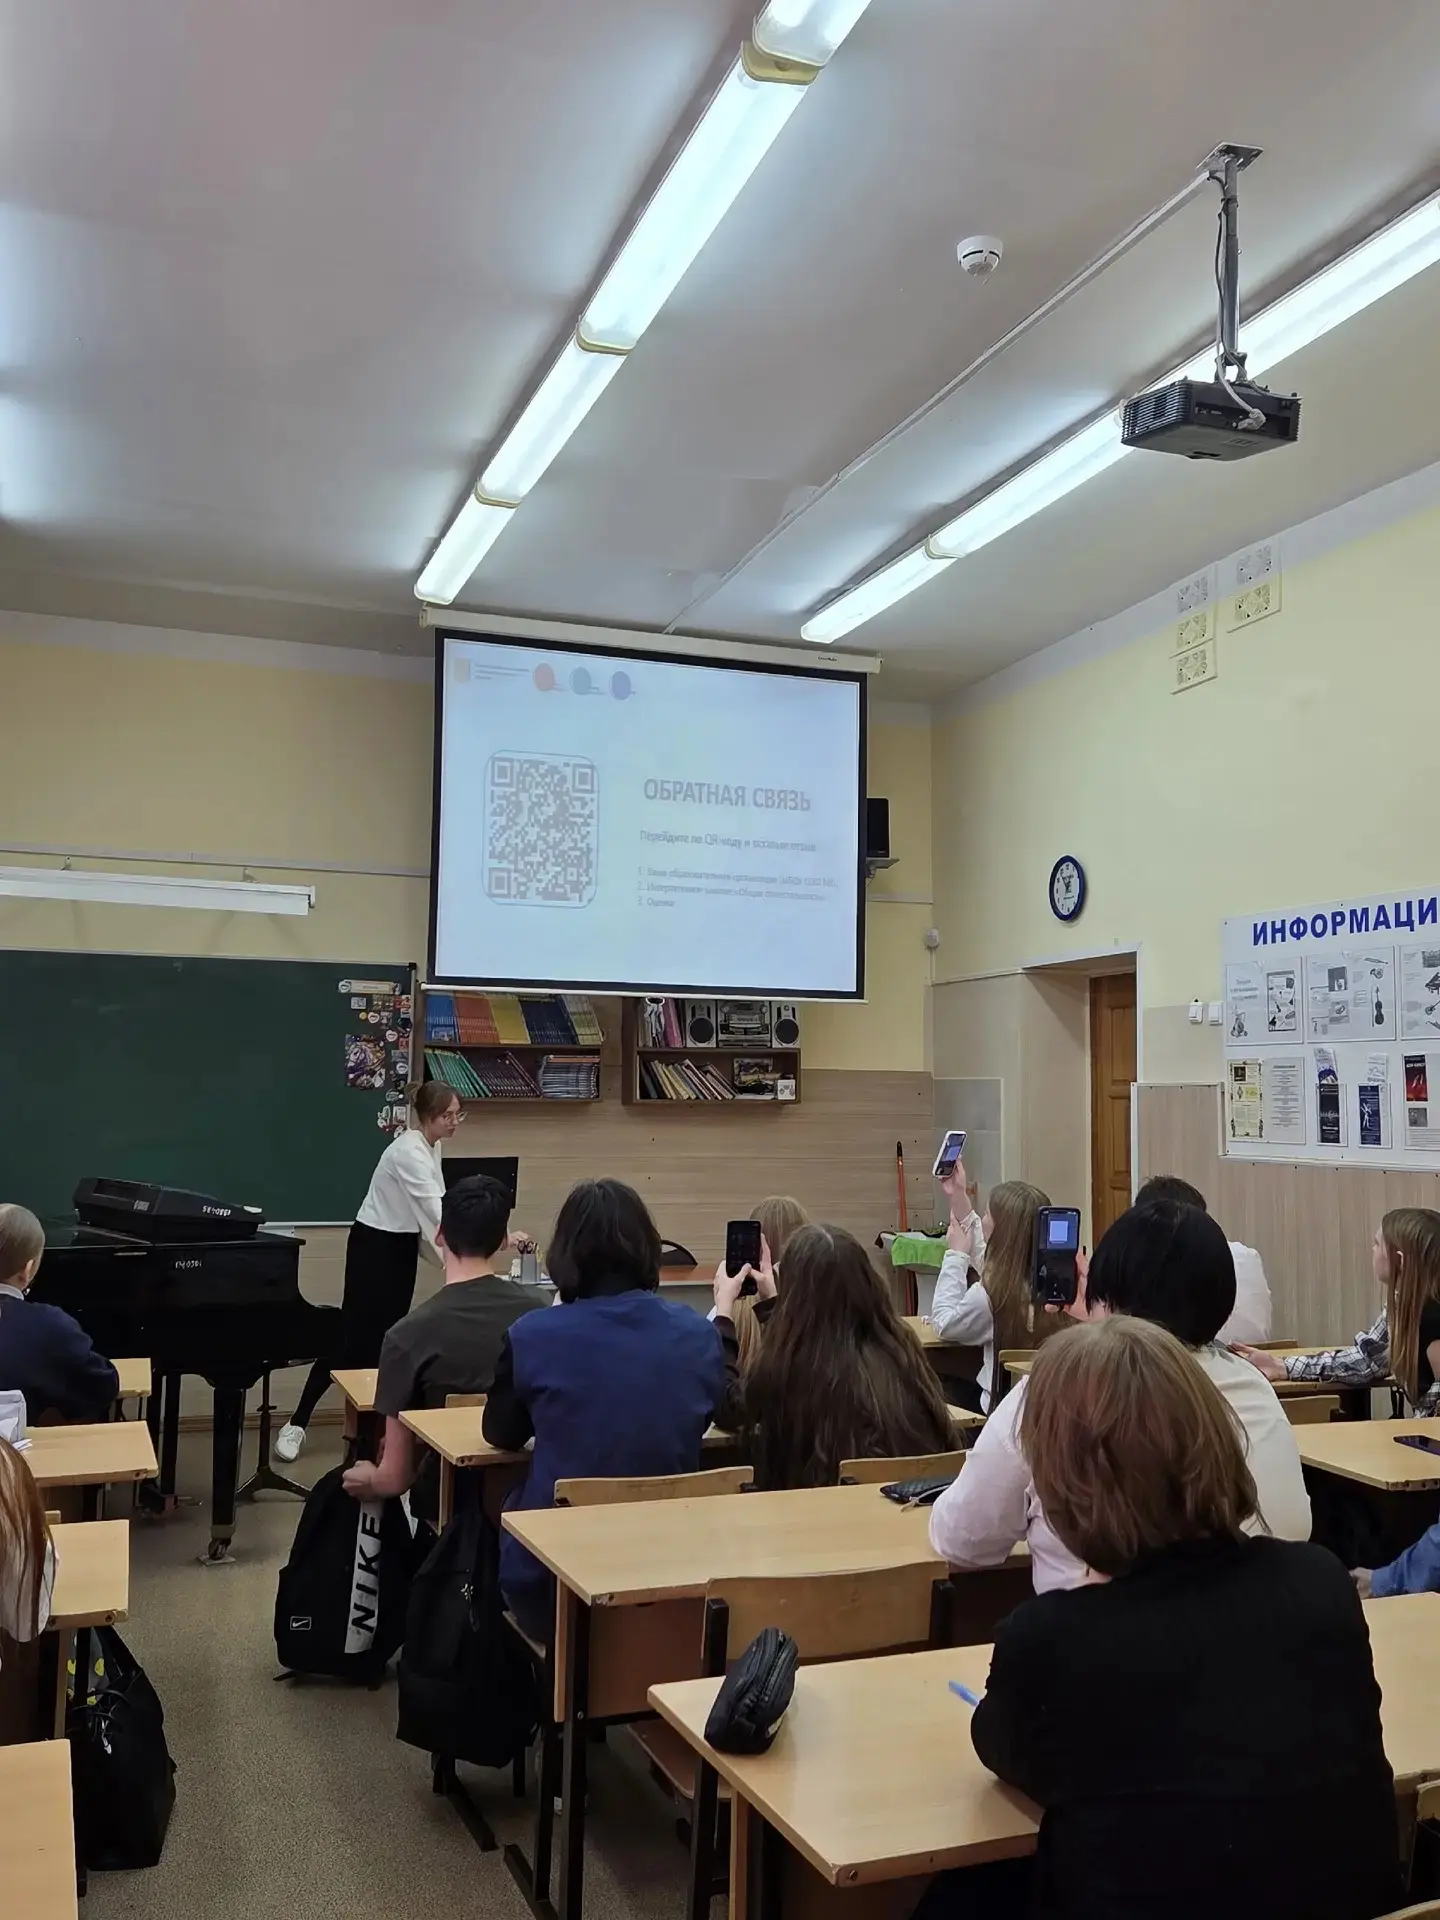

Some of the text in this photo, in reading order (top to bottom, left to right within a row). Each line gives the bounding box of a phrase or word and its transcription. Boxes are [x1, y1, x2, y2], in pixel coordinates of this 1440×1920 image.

[643, 777, 812, 812] ОБРАТНАЯ СВЯЗЬ
[1252, 896, 1438, 947] ИНФОРМАЦИ
[351, 1511, 382, 1634] NIKE
